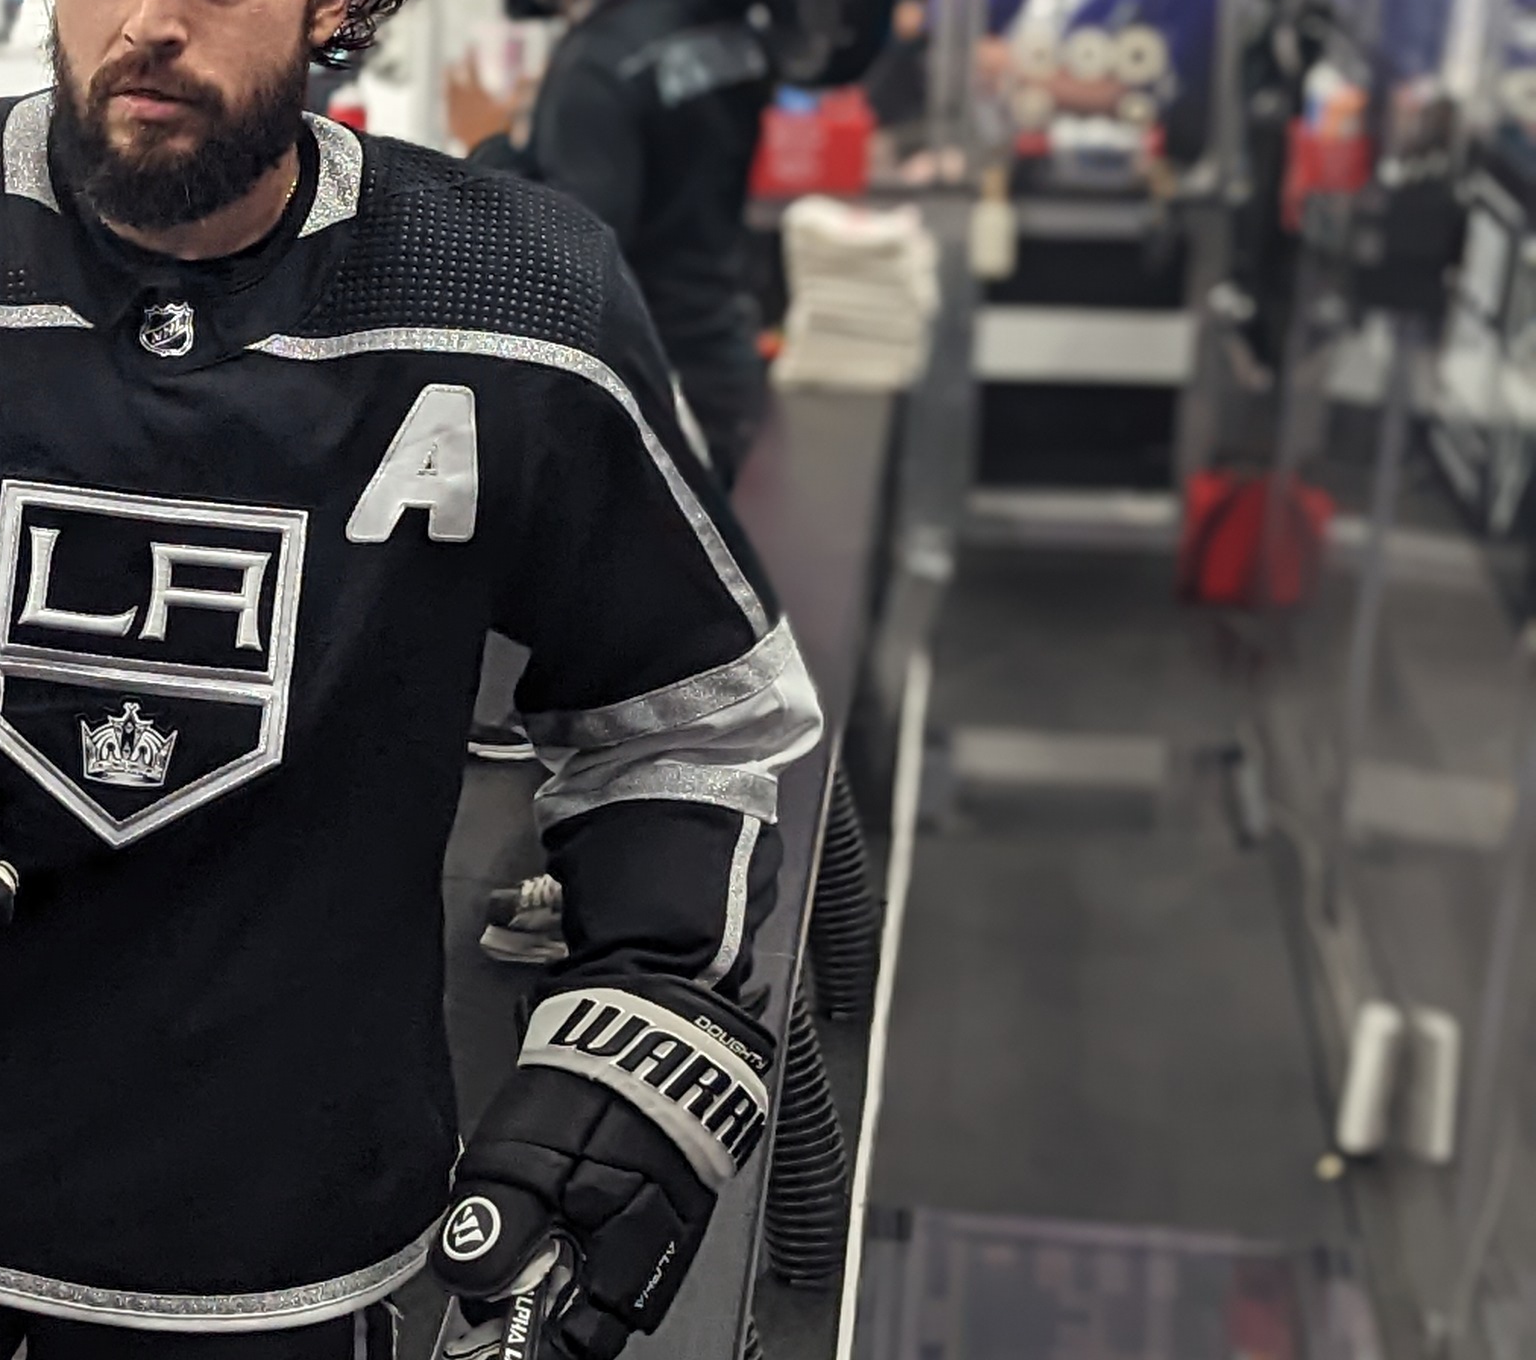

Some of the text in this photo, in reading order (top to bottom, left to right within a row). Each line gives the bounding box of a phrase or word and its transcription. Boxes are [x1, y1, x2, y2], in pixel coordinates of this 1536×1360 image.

[345, 383, 479, 543] A
[17, 525, 272, 652] LA
[693, 1014, 766, 1071] DOUGHTY
[633, 1240, 676, 1309] ALPHA
